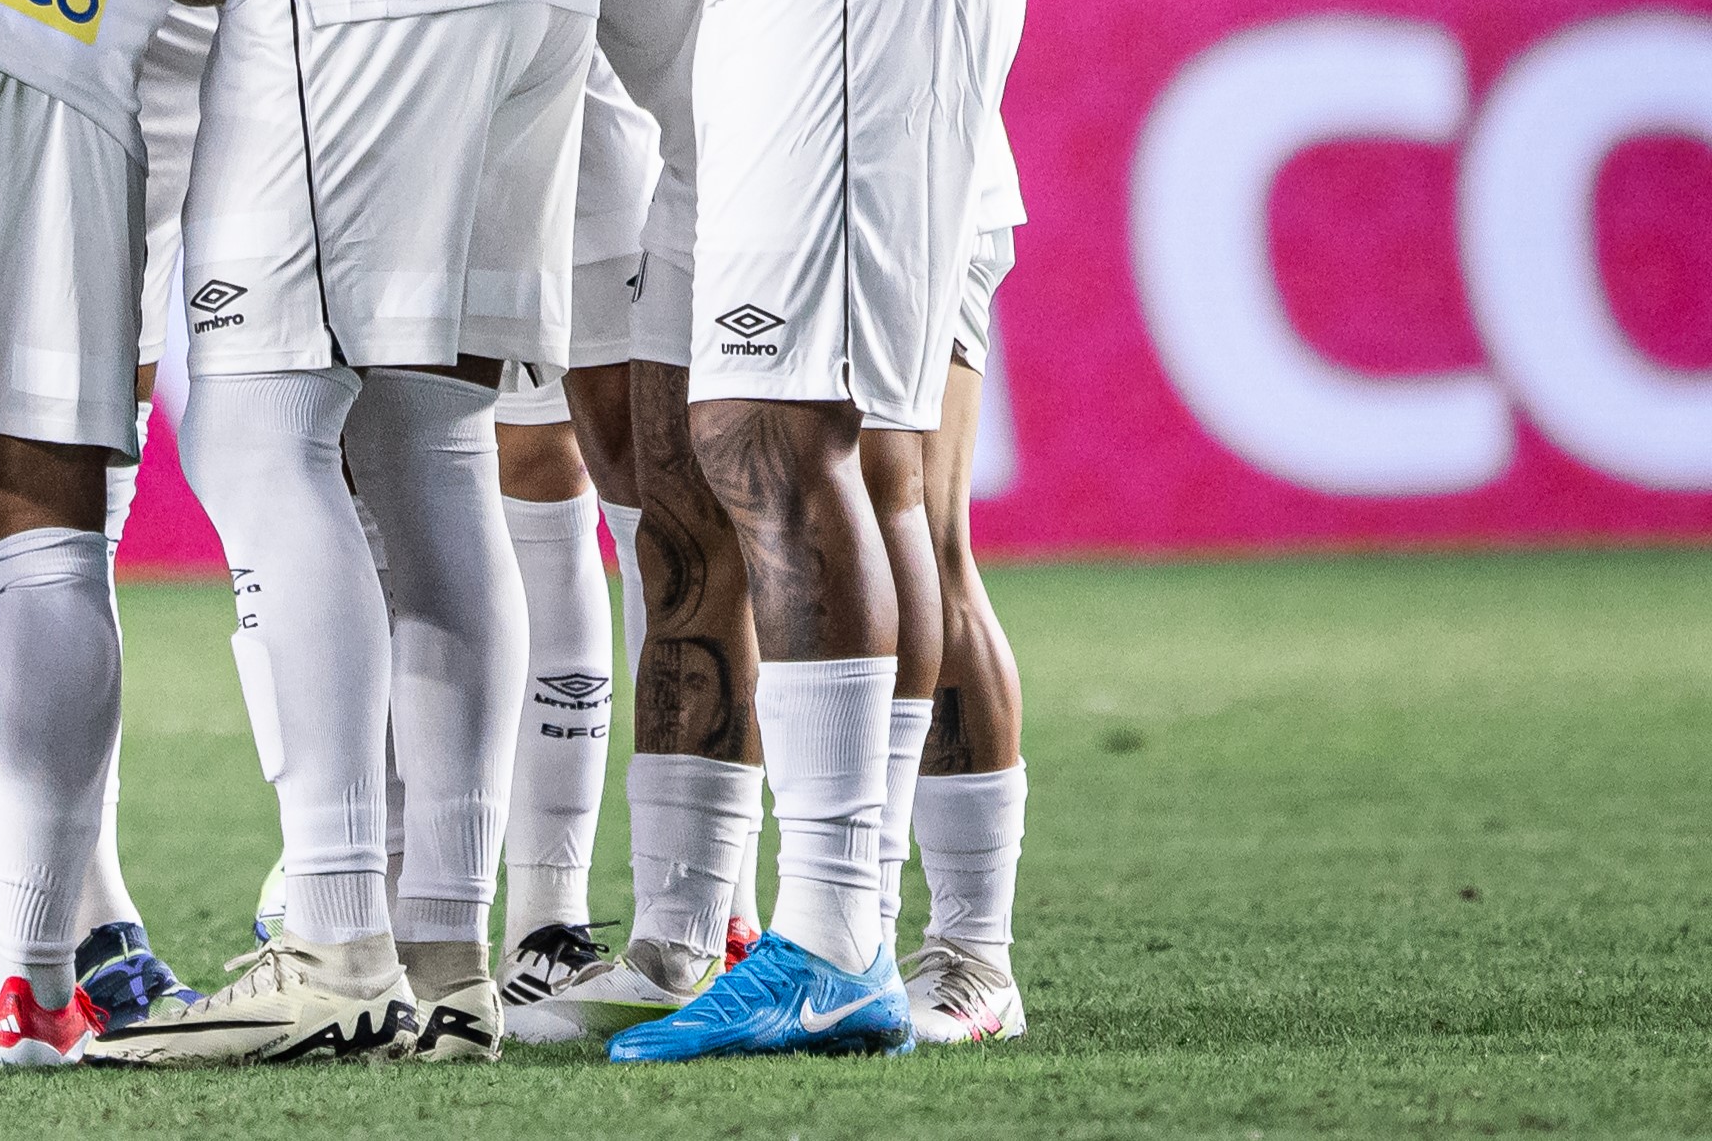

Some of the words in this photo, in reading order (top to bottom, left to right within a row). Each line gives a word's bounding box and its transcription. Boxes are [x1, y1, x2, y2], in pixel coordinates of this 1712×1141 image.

[194, 314, 244, 334] umbro
[721, 341, 778, 356] umbro
[541, 723, 606, 739] SFC
